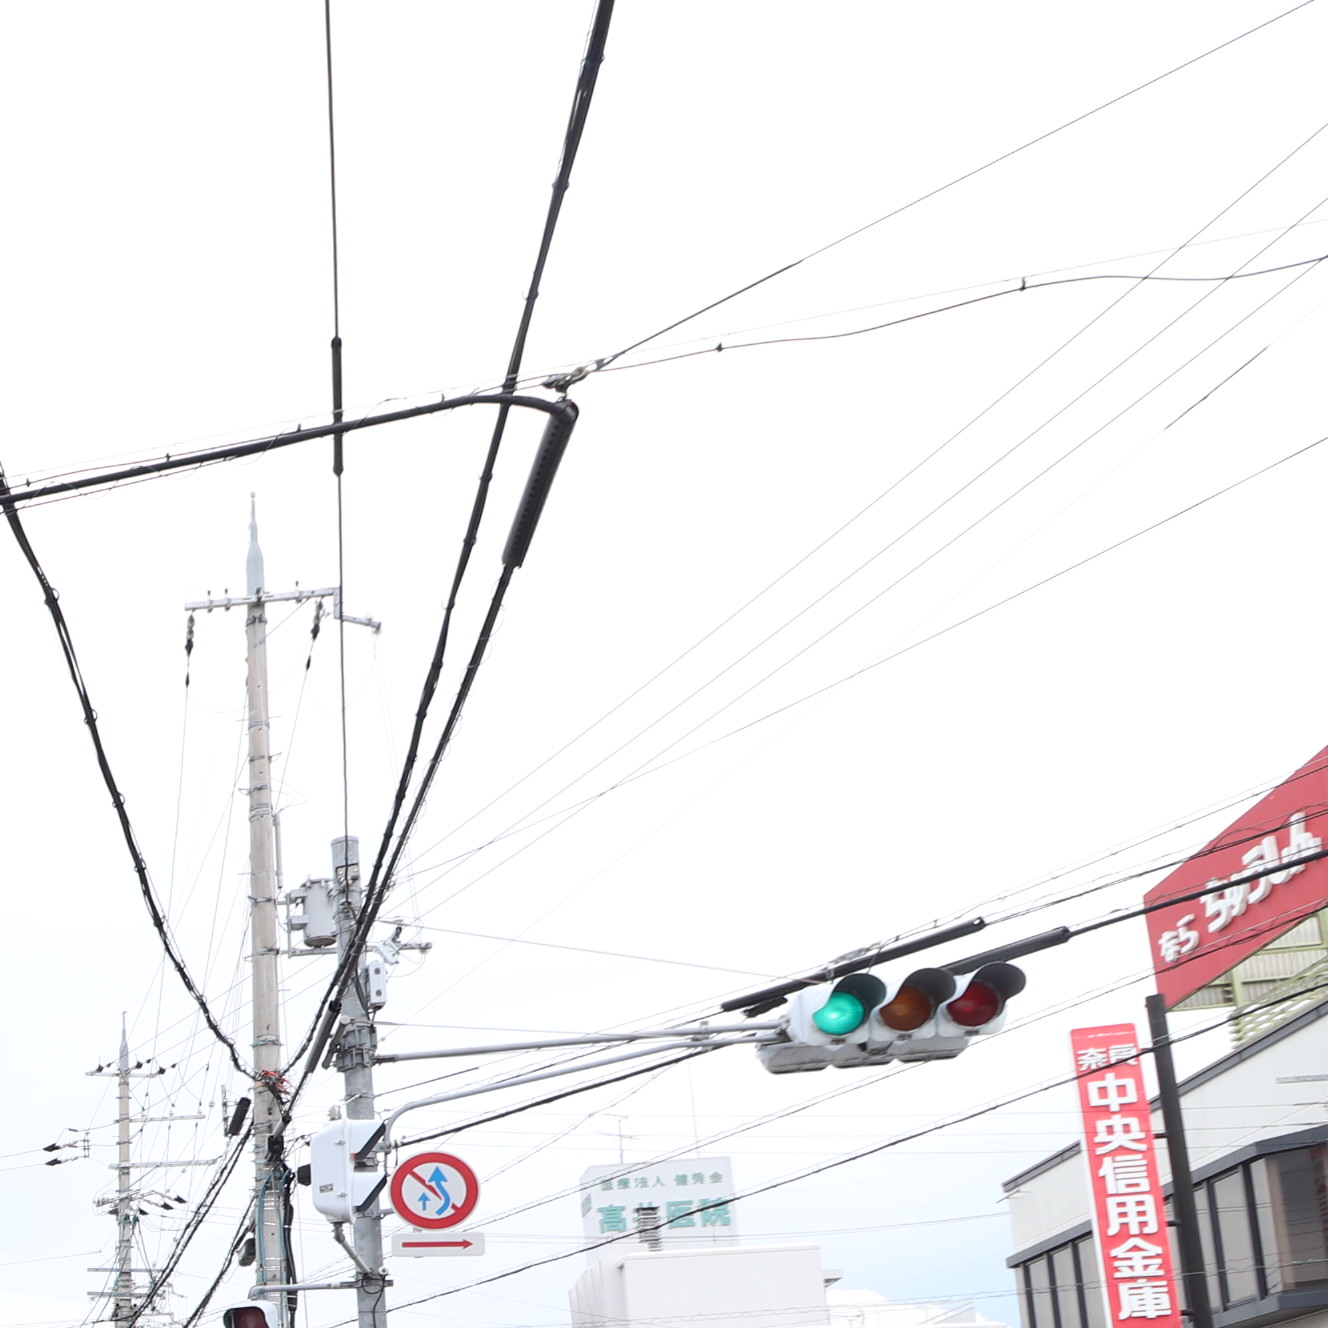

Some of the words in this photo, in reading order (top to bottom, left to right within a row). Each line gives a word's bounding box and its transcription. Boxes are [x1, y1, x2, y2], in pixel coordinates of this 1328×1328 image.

[1088, 1072, 1173, 1321] 中央信用金庫
